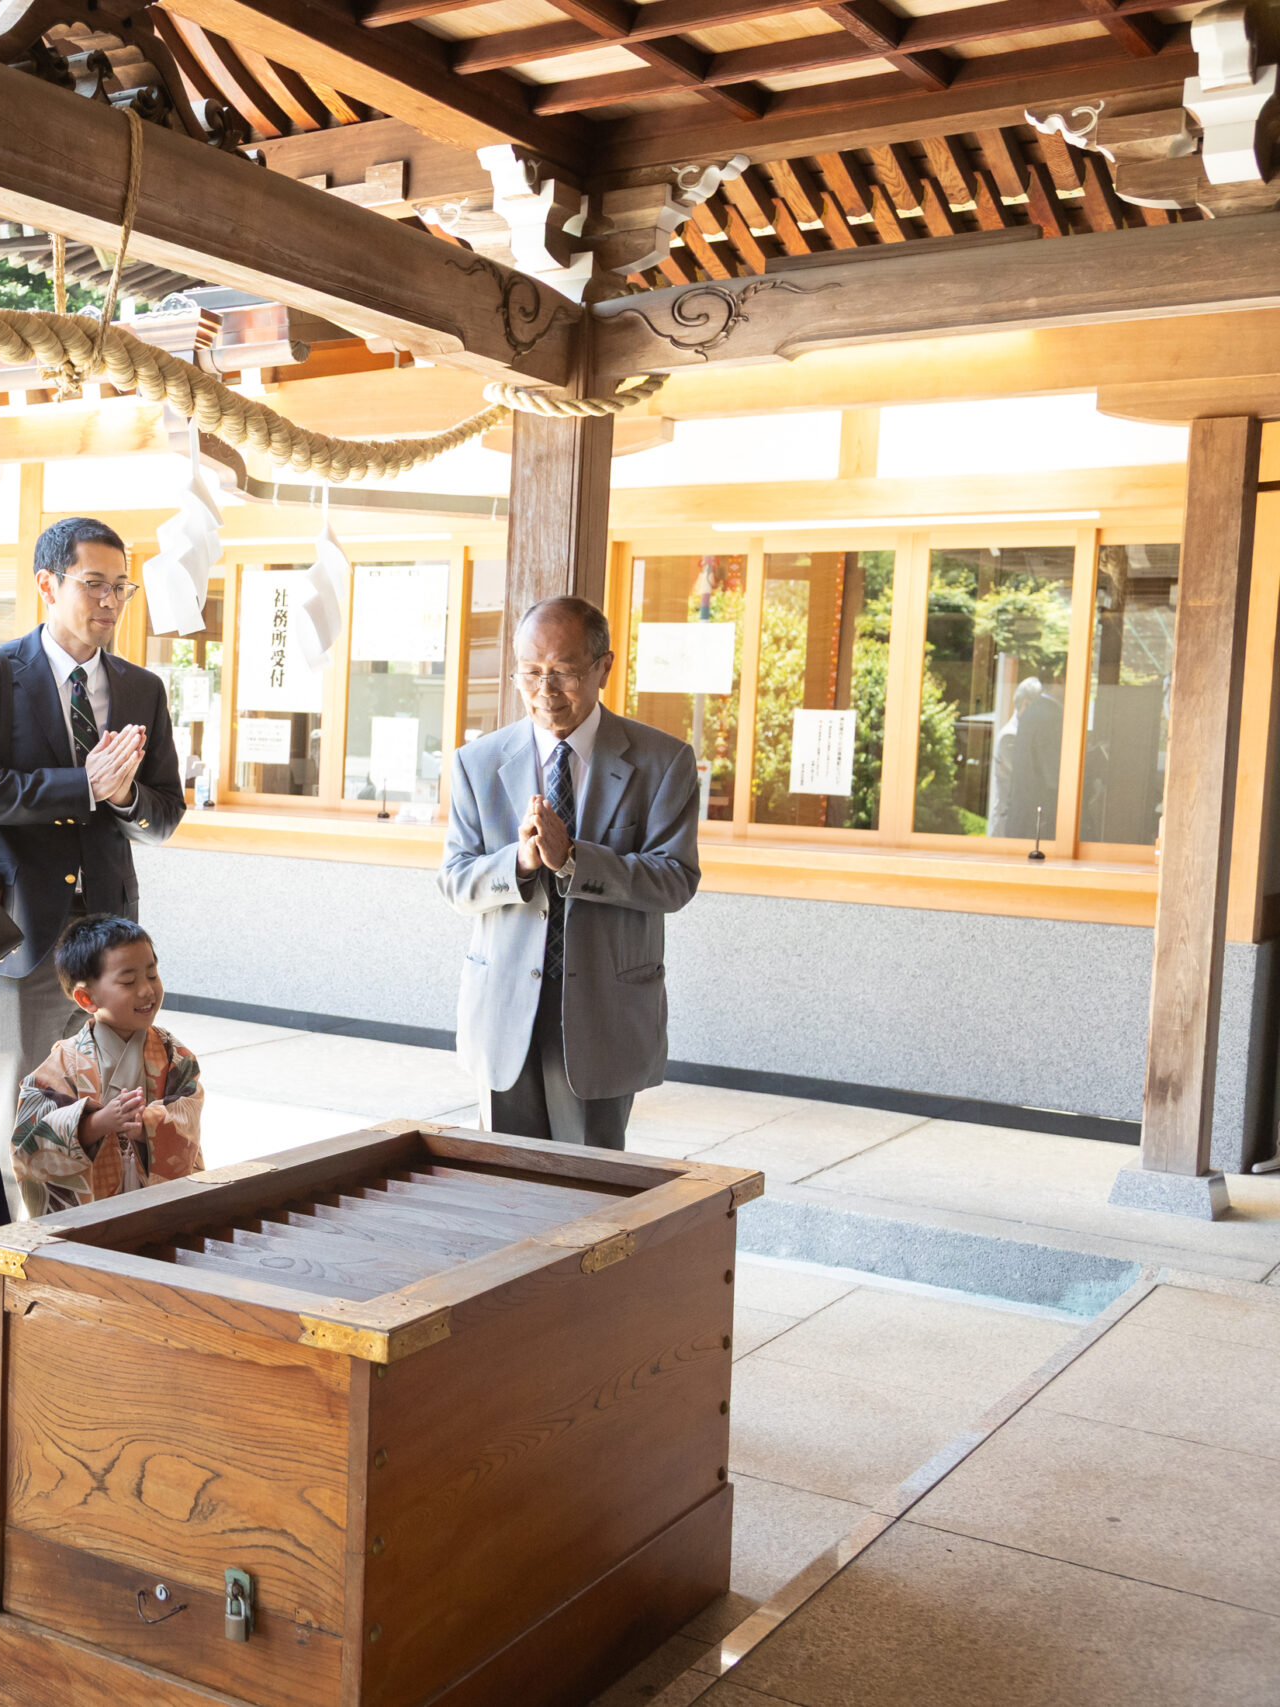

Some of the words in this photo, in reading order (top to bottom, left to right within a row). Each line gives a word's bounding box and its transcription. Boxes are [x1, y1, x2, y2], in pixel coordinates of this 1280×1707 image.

[271, 588, 288, 688] 社務所受付
